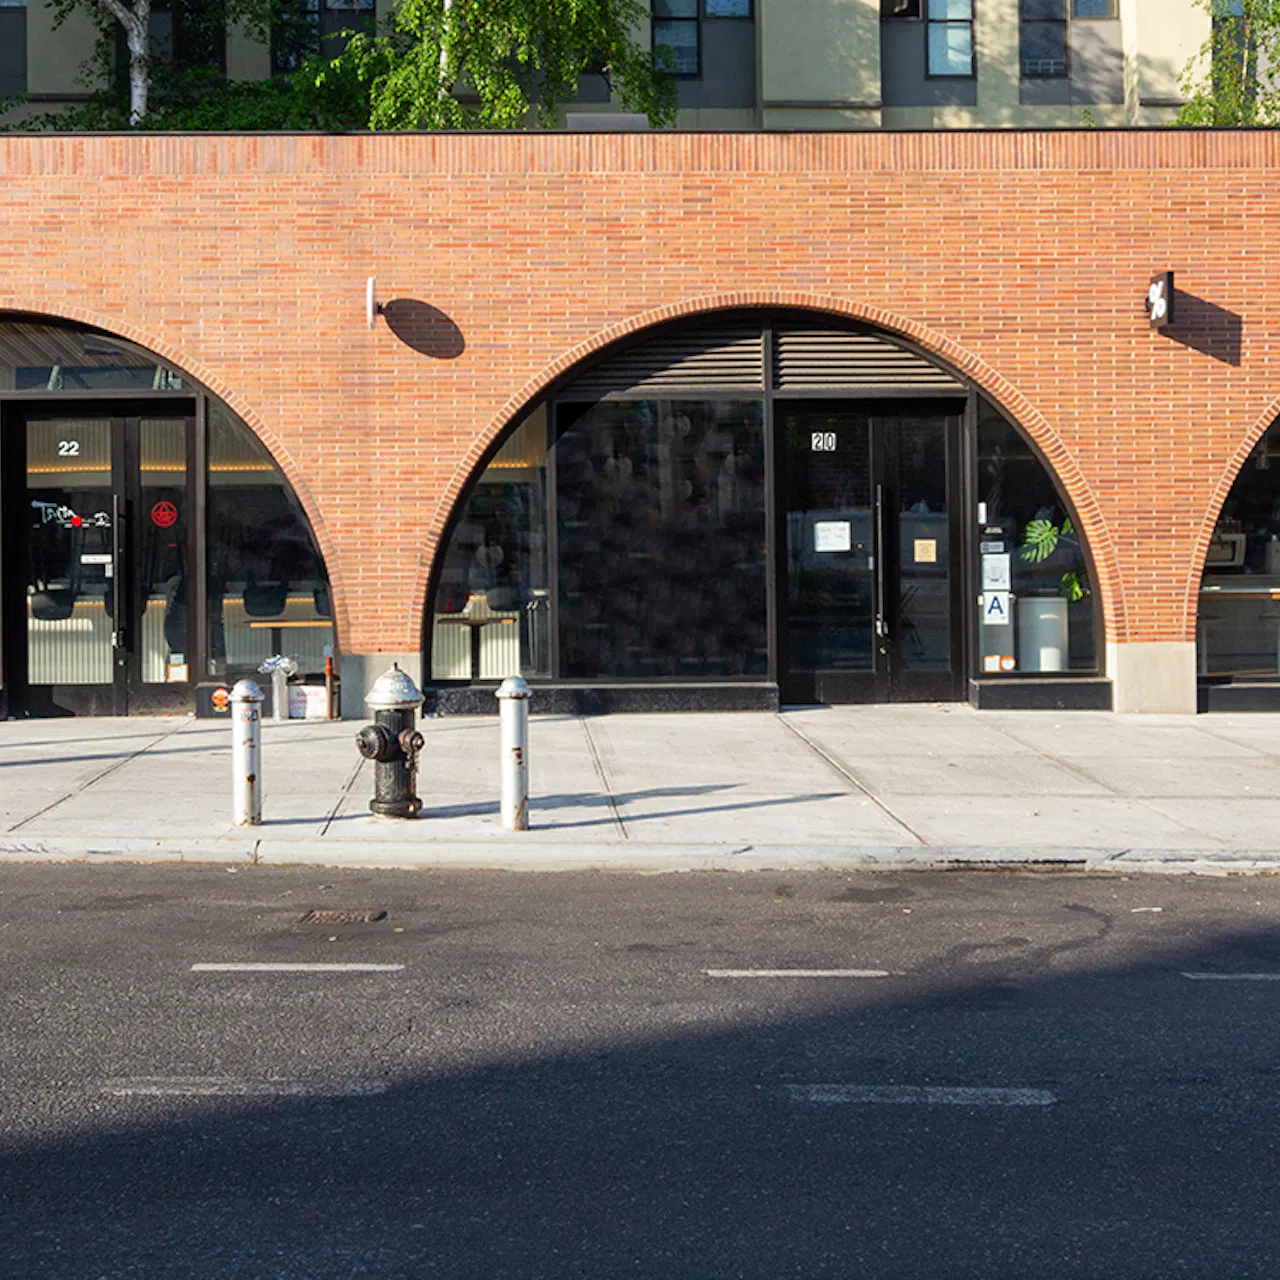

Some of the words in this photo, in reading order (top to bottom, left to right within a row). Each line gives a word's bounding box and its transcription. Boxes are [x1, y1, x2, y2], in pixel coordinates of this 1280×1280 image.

[58, 440, 80, 456] 22
[812, 432, 836, 451] 20
[987, 595, 1004, 615] A
